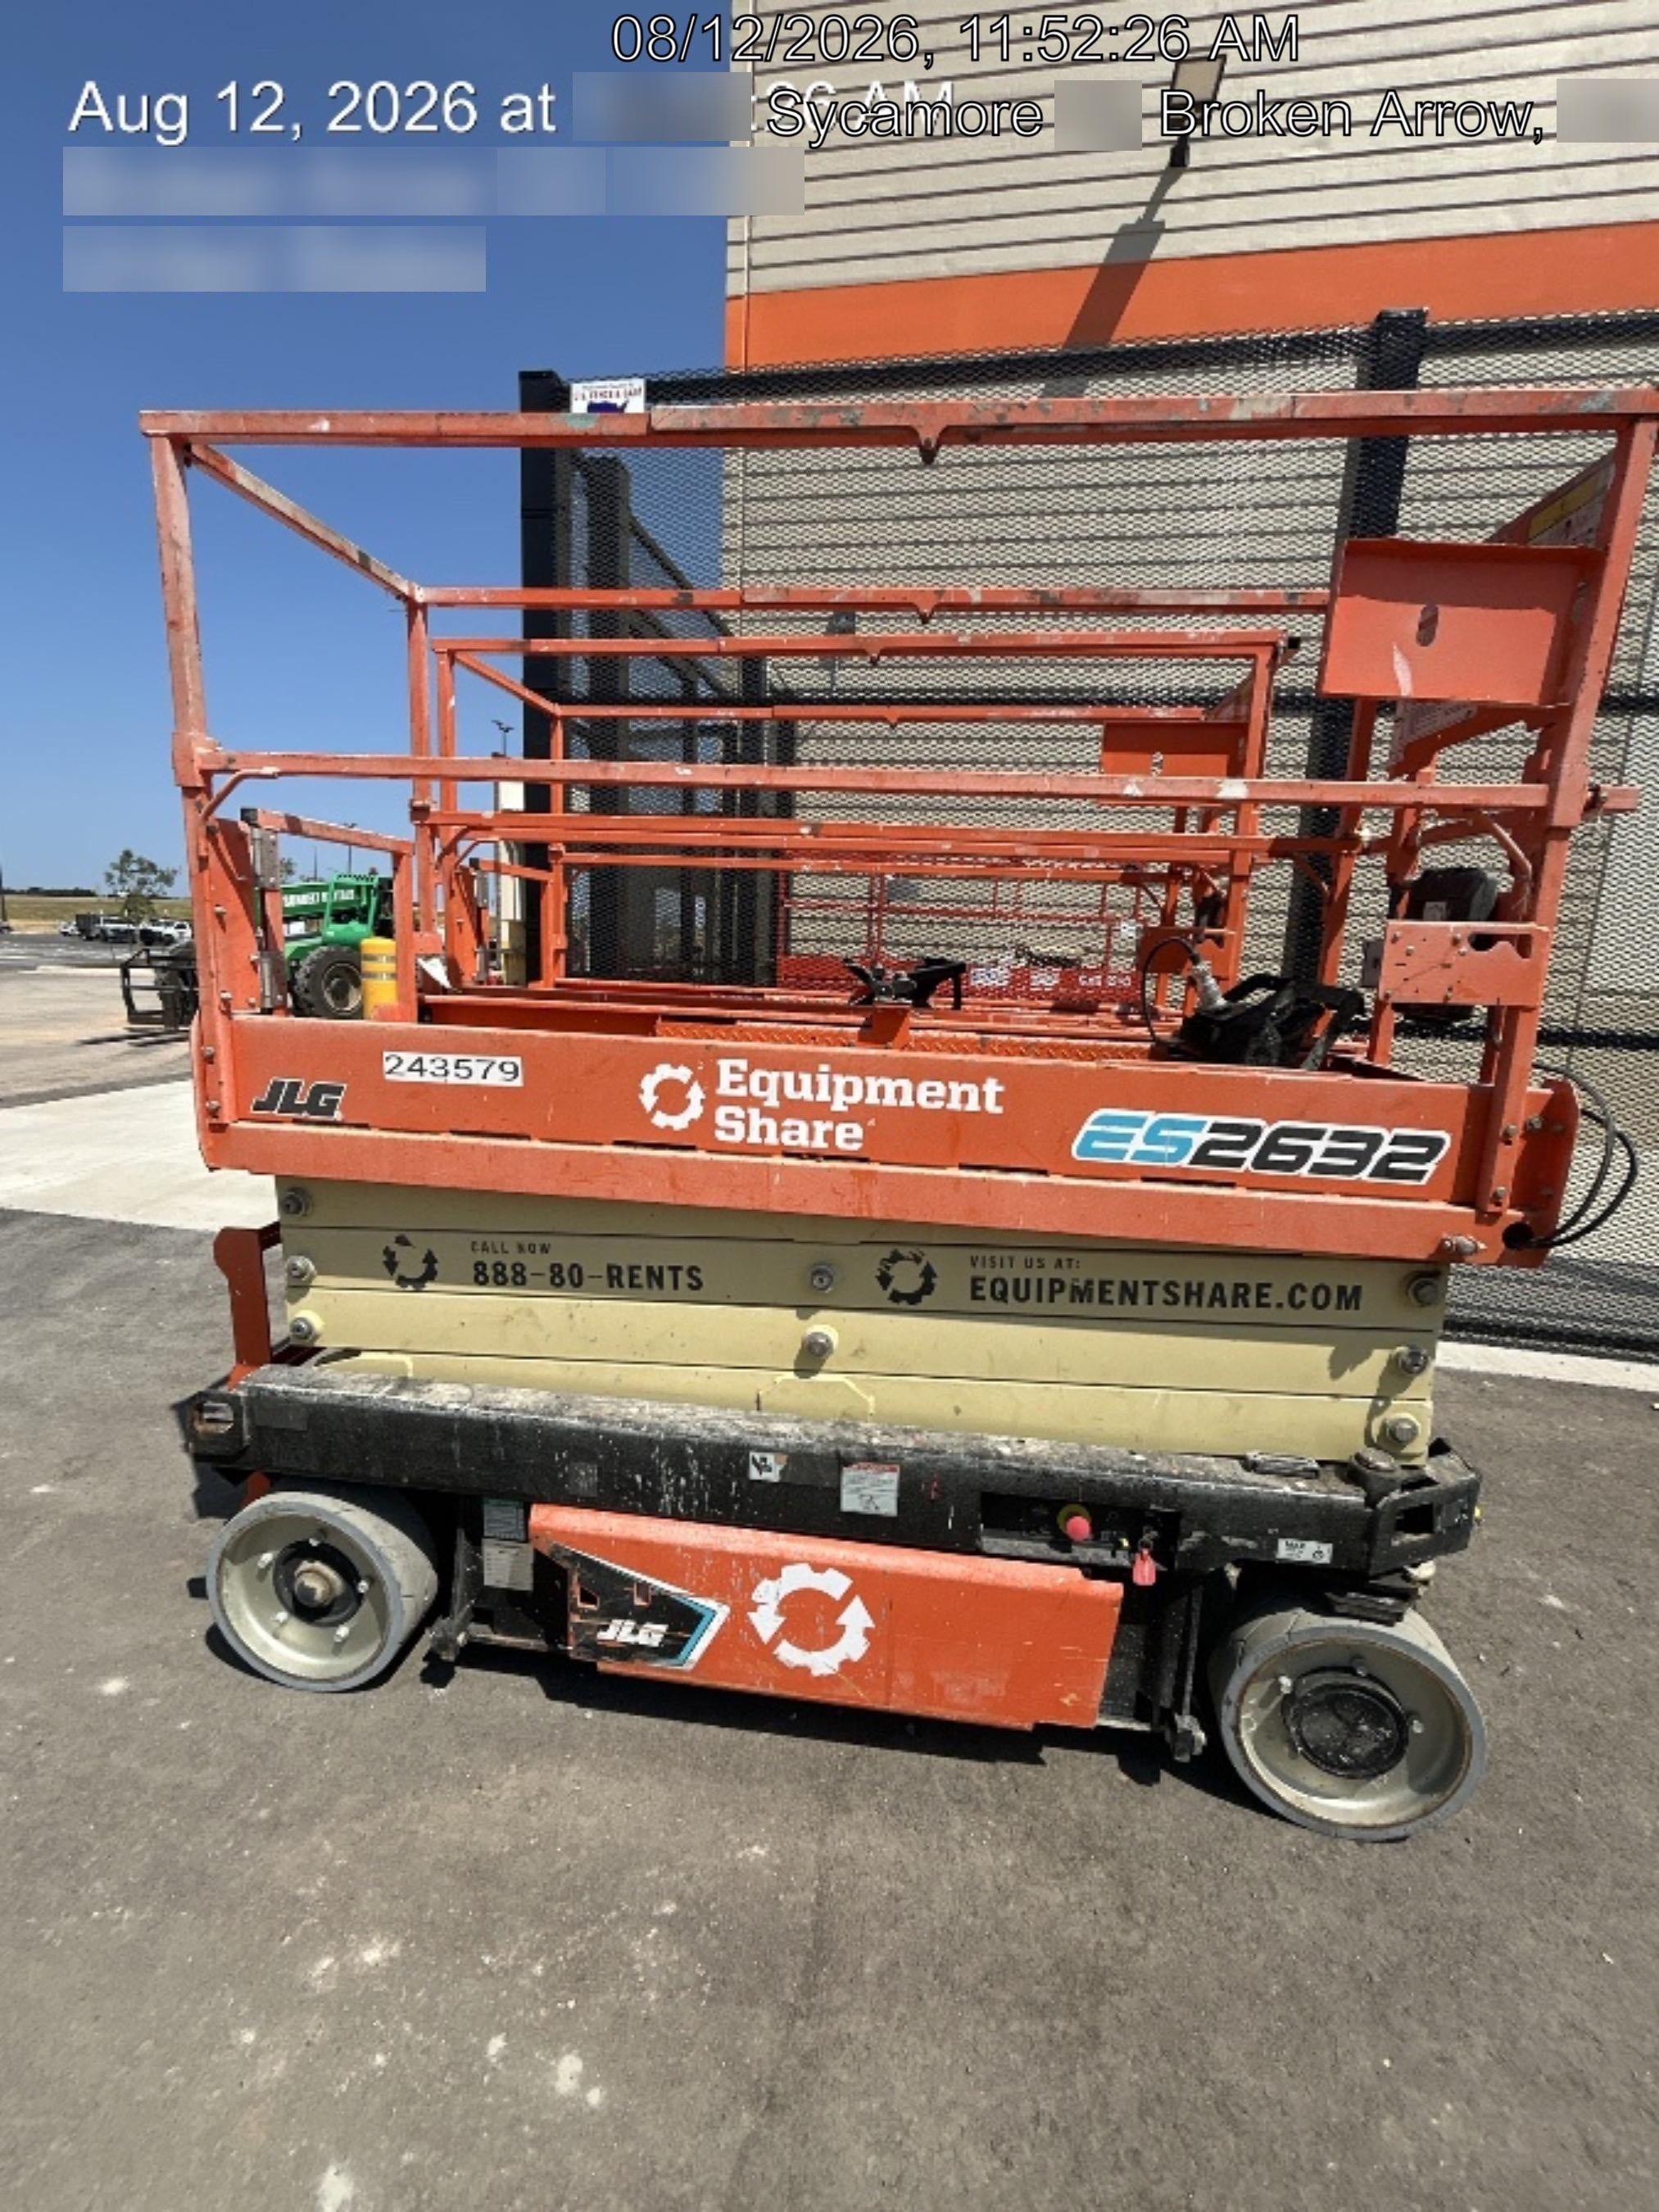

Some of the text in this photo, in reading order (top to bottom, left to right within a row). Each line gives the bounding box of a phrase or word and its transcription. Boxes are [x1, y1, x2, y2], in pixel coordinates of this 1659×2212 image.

[384, 1054, 520, 1083] 243579
[250, 1076, 348, 1121] JLG
[714, 1058, 1005, 1114] Equipment
[714, 1104, 864, 1151] Share
[1071, 1108, 1451, 1185] ES2632
[470, 1240, 552, 1255] CALL NOW
[969, 1255, 1081, 1270] VISIT US AT:
[472, 1260, 704, 1291] 888-80-RENTS
[969, 1275, 1363, 1312] EQUIPMENTSHARE.COM
[596, 1619, 669, 1648] JLG
